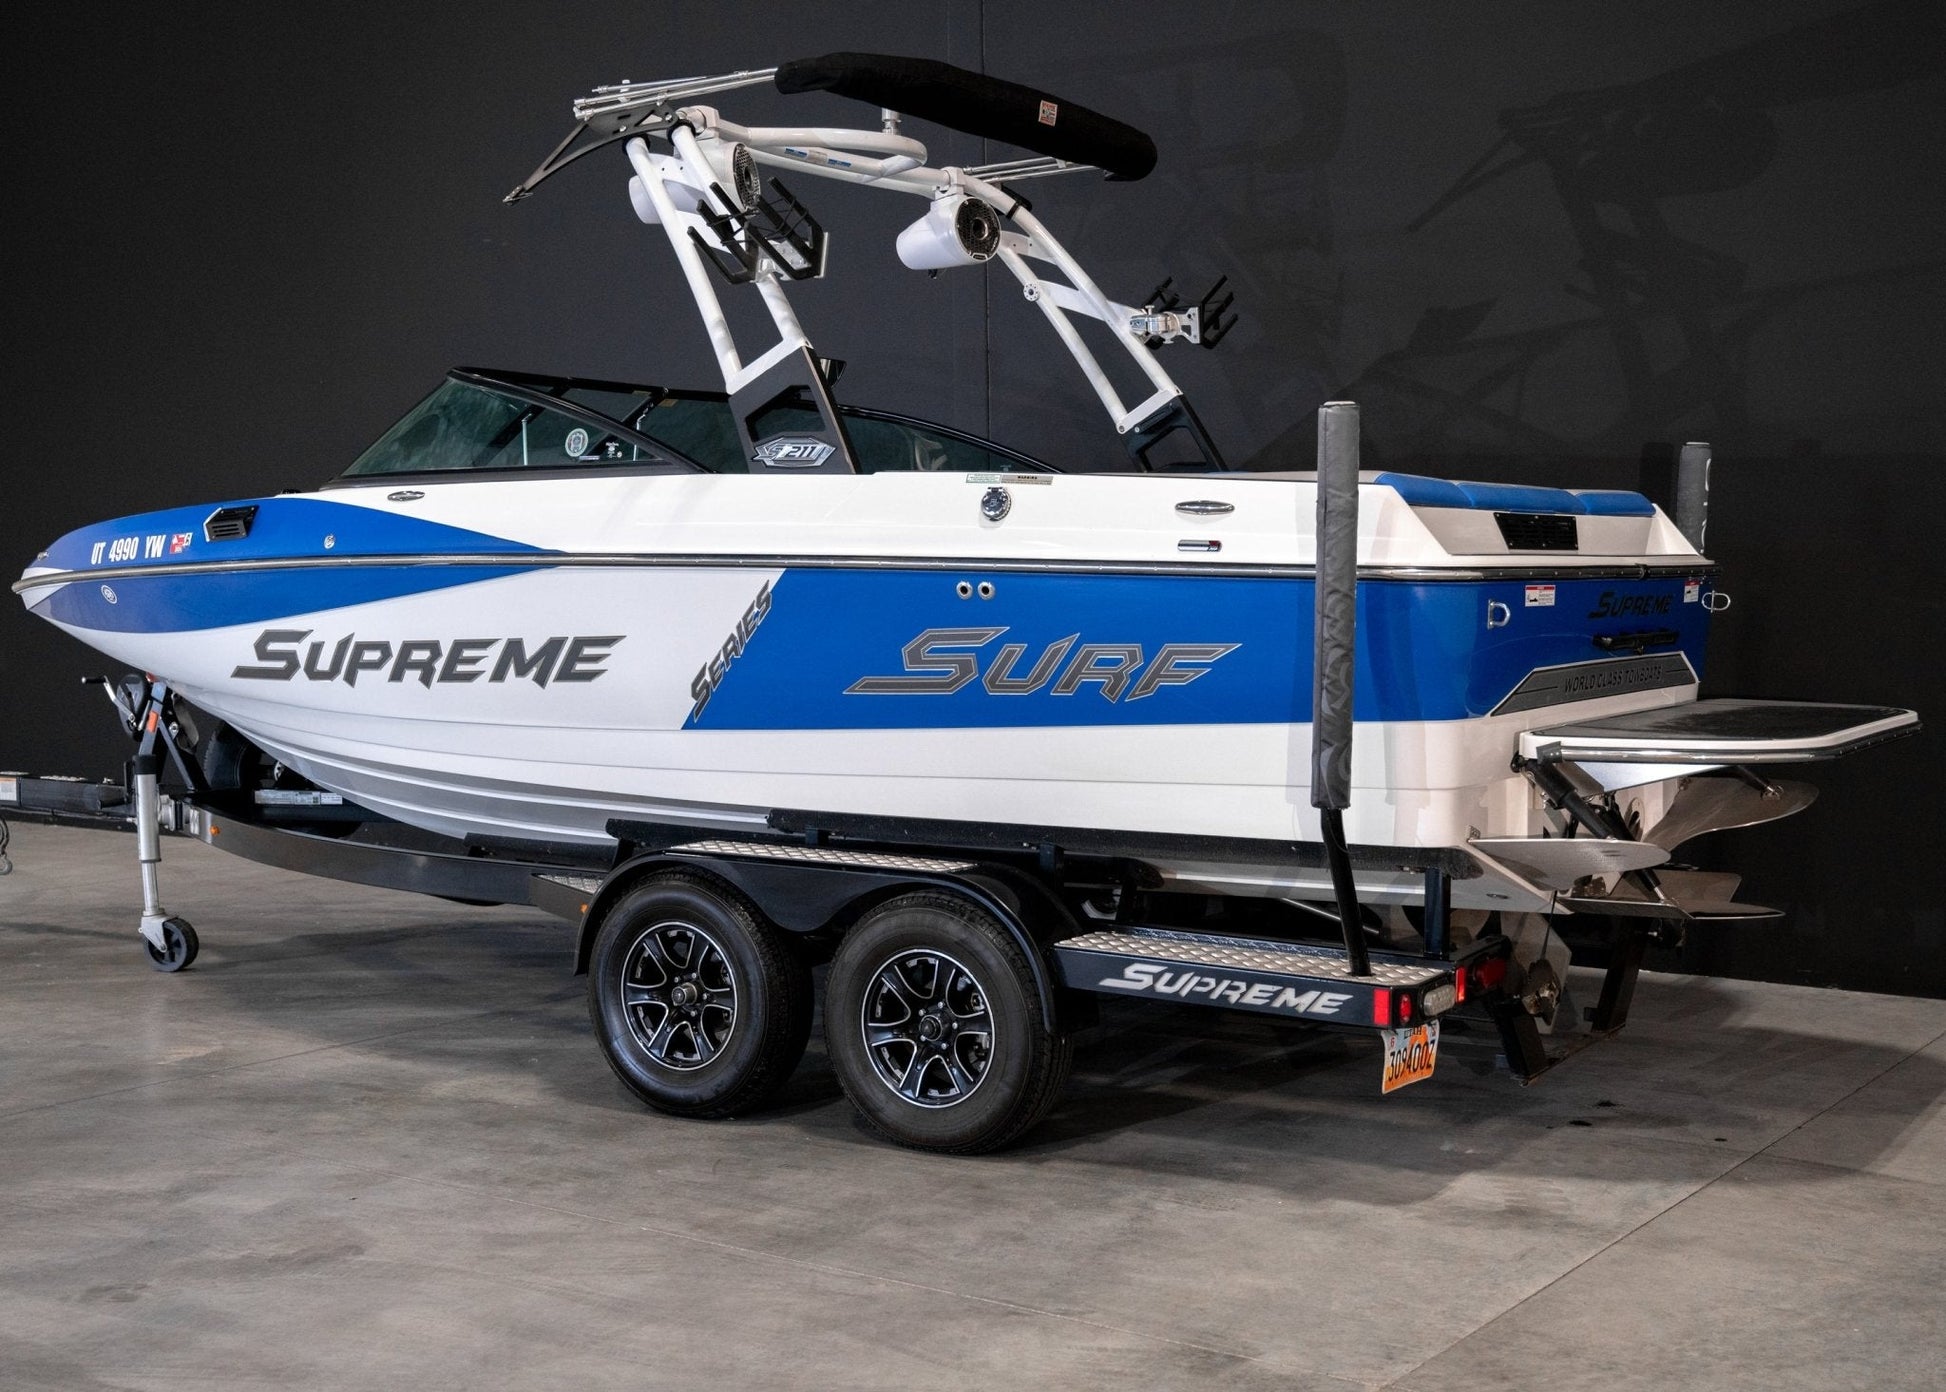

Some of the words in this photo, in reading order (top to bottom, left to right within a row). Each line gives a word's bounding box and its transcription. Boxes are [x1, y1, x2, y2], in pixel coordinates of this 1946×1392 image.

[91, 541, 106, 565] UT
[108, 536, 140, 563] 4990
[144, 534, 167, 559] YW
[1588, 591, 1674, 619] SUPREME
[230, 628, 627, 690] SUPREME
[690, 579, 773, 724] SERIES
[842, 626, 1243, 704] SURF
[1564, 673, 1598, 693] WORLD
[1597, 668, 1624, 689] CLASS
[1098, 963, 1355, 1015] SUPREME
